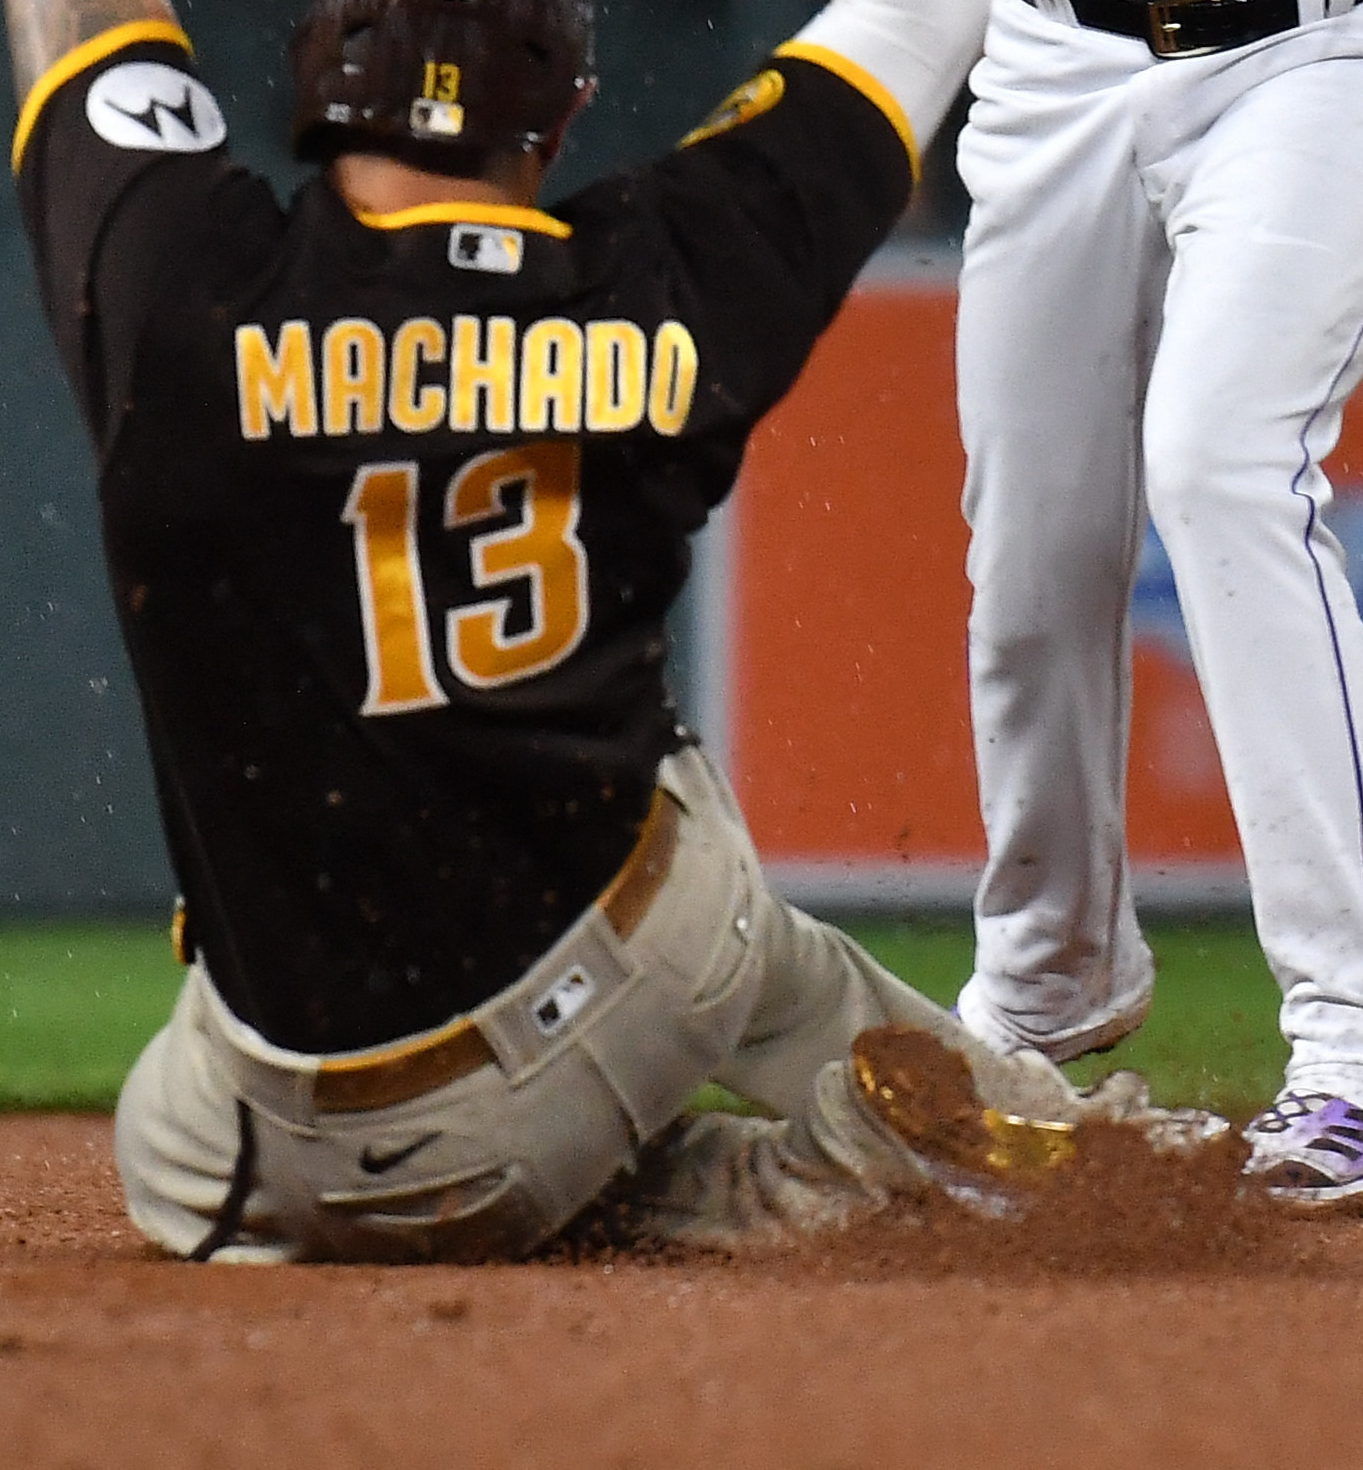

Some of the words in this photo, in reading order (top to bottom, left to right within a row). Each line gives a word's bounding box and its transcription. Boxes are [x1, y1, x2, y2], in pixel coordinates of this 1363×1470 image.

[422, 60, 461, 103] 13
[235, 314, 699, 441] MACHADO
[340, 438, 590, 717] 13
